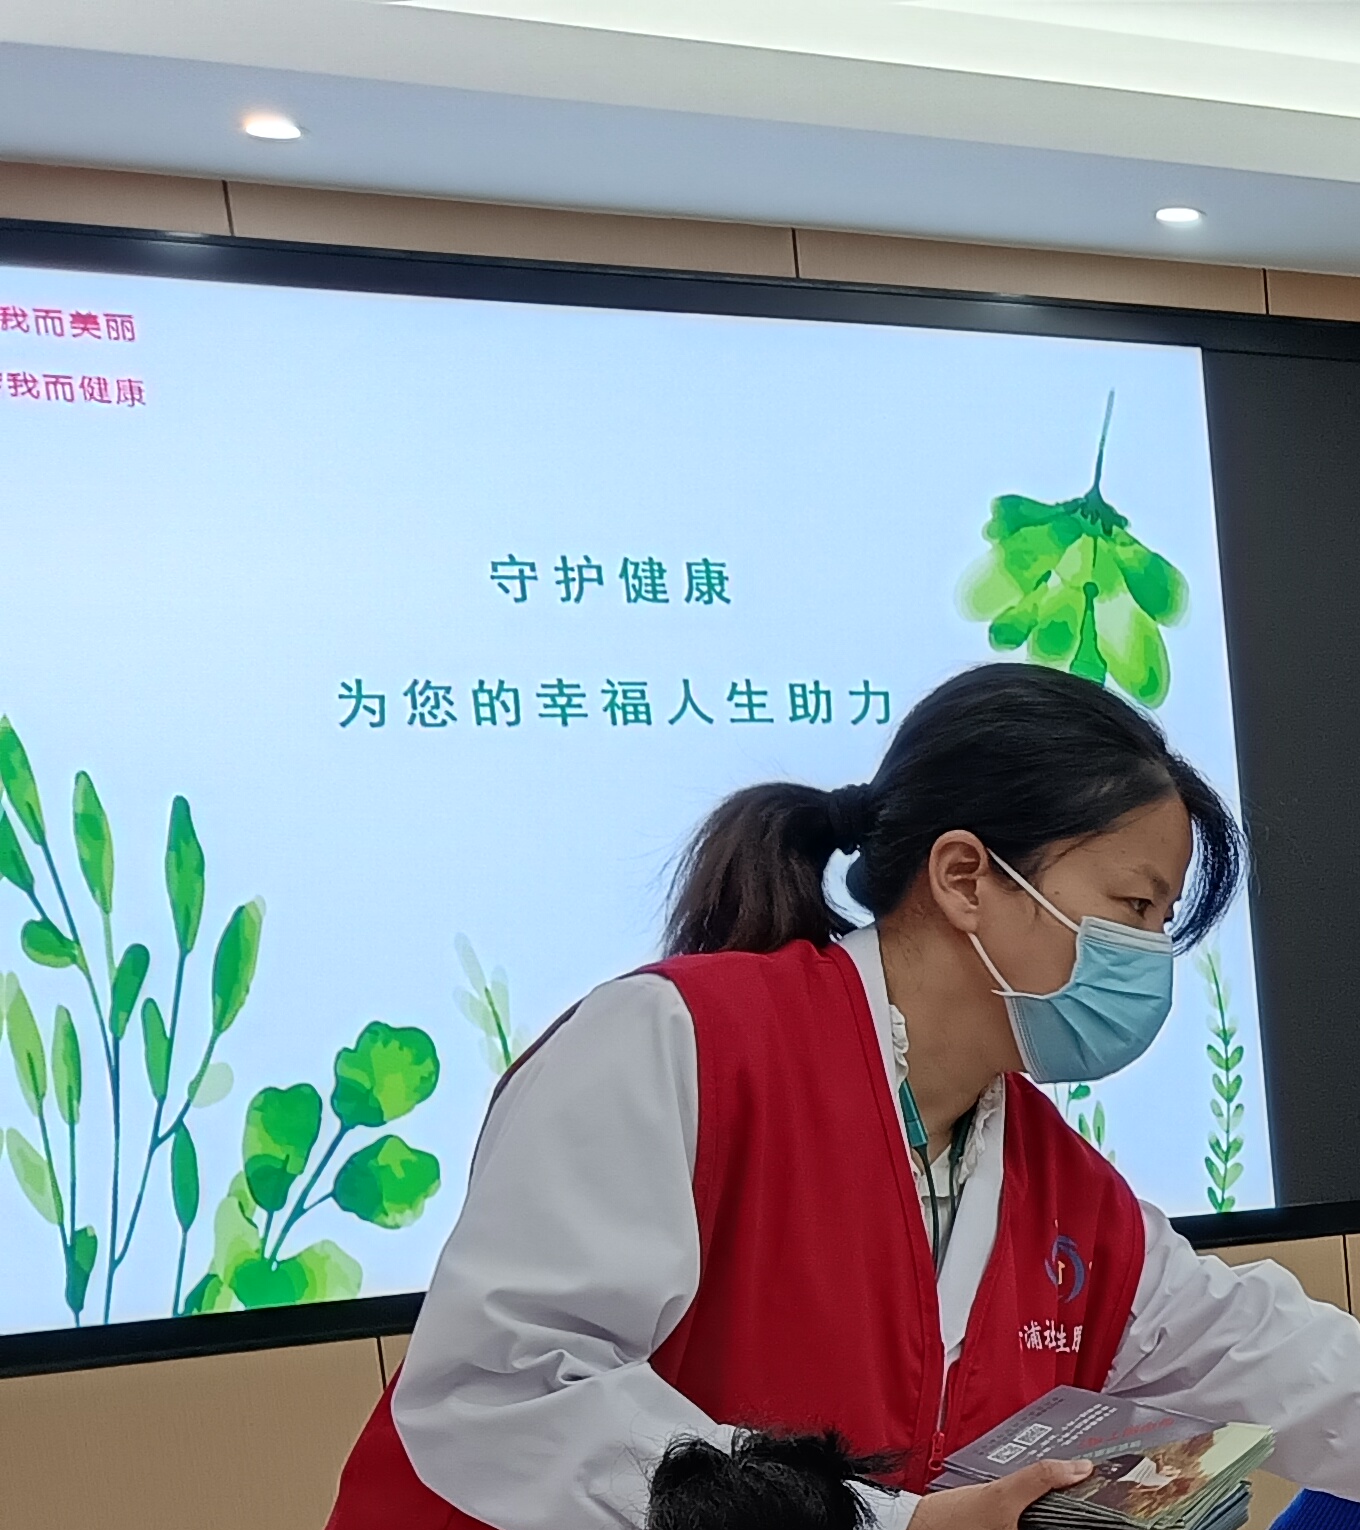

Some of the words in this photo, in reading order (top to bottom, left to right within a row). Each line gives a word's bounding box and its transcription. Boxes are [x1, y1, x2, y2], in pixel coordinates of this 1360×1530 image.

[0, 305, 136, 342] 我而美丽
[0, 371, 147, 407] 我而健康
[489, 553, 732, 605] 守护健康
[337, 677, 893, 728] 为您的幸福人生助力
